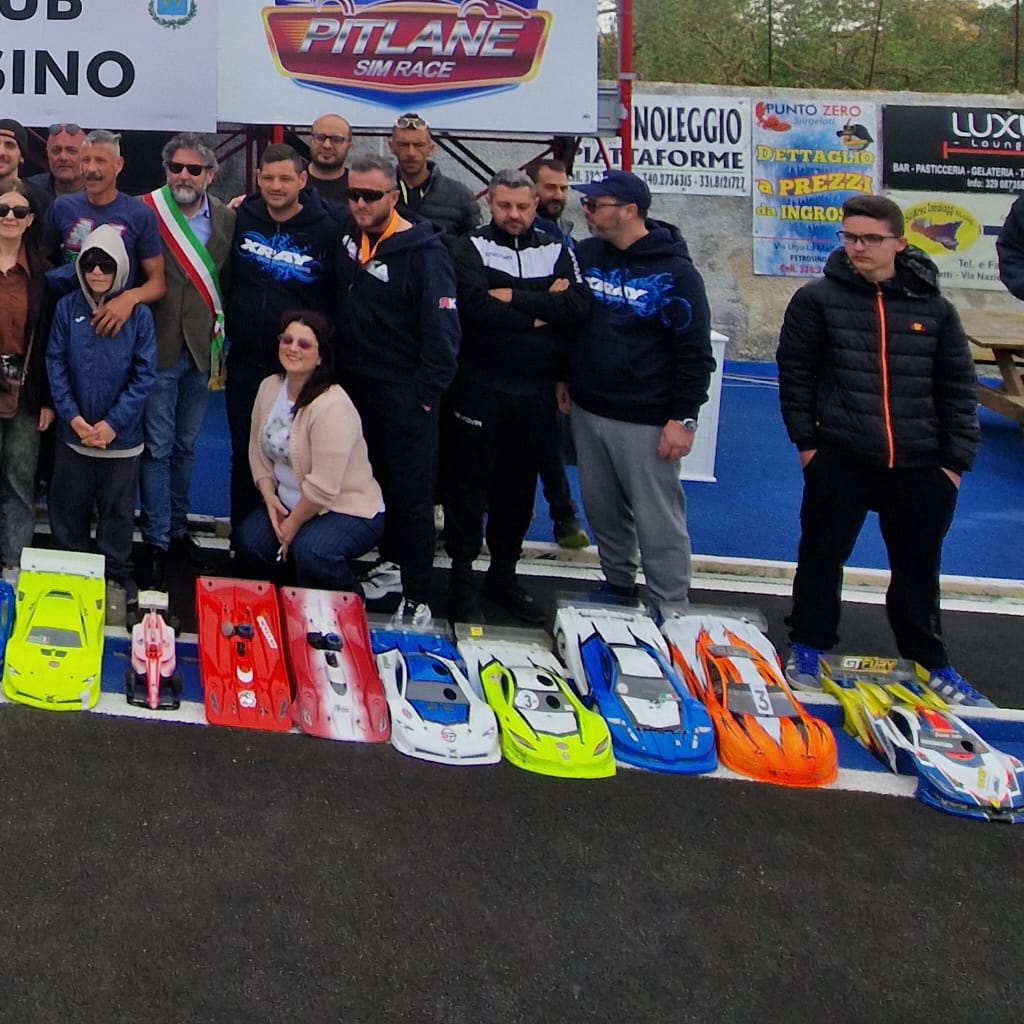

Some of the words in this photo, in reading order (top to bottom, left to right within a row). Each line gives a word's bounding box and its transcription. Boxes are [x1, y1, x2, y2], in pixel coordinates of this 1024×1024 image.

[299, 18, 524, 57] PITLANE
[353, 60, 394, 76] SIM
[393, 60, 456, 78] RACE
[766, 103, 818, 116] PUNTO
[822, 105, 862, 117] ZERO
[634, 106, 743, 145] NOLEGGIO
[756, 144, 875, 165] DETTAGLIO
[893, 163, 910, 173] BAR
[916, 164, 966, 176] PASTICCERIA
[778, 172, 873, 197] PREZZI
[756, 203, 777, 217] da
[754, 689, 770, 712] 3
